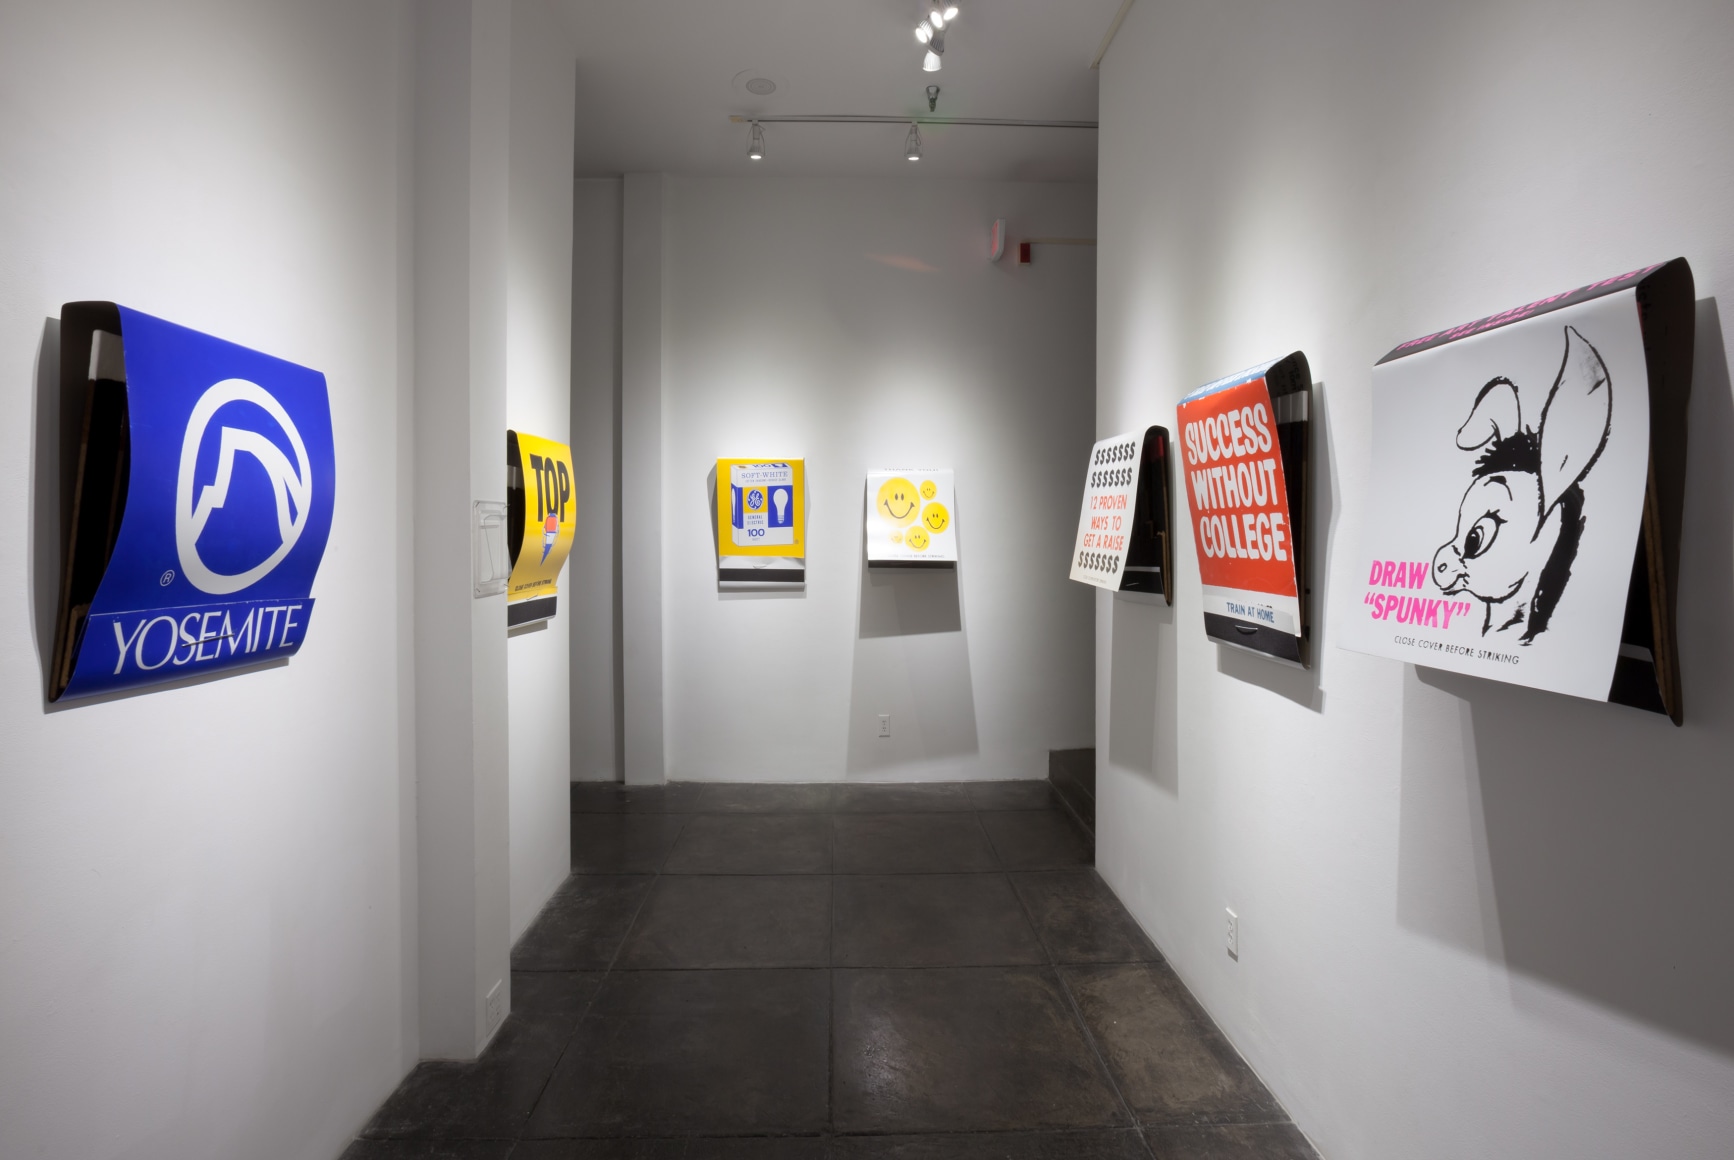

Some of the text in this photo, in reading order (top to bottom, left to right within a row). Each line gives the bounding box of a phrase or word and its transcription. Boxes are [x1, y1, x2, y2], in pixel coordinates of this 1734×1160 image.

[1486, 289, 1580, 322] TALENT
[1586, 262, 1664, 291] TEST
[1185, 402, 1272, 465] SUCCESS
[530, 453, 570, 522] TOP
[741, 471, 788, 479] SOFT-WHITE
[1191, 458, 1278, 511] WITHOUT
[1090, 494, 1128, 511] 12 PROVEN
[747, 528, 765, 537] 100
[1091, 516, 1122, 531] WAYS TO
[1199, 513, 1287, 561] COLLEGE
[1084, 533, 1125, 551] GET A RAISE
[1369, 560, 1429, 590] DRAW
[1226, 602, 1275, 623] TRAIN AT HOME
[113, 604, 303, 675] YOSEMITE
[1394, 635, 1520, 665] CLOSE COVER BEFORE STRIKING
